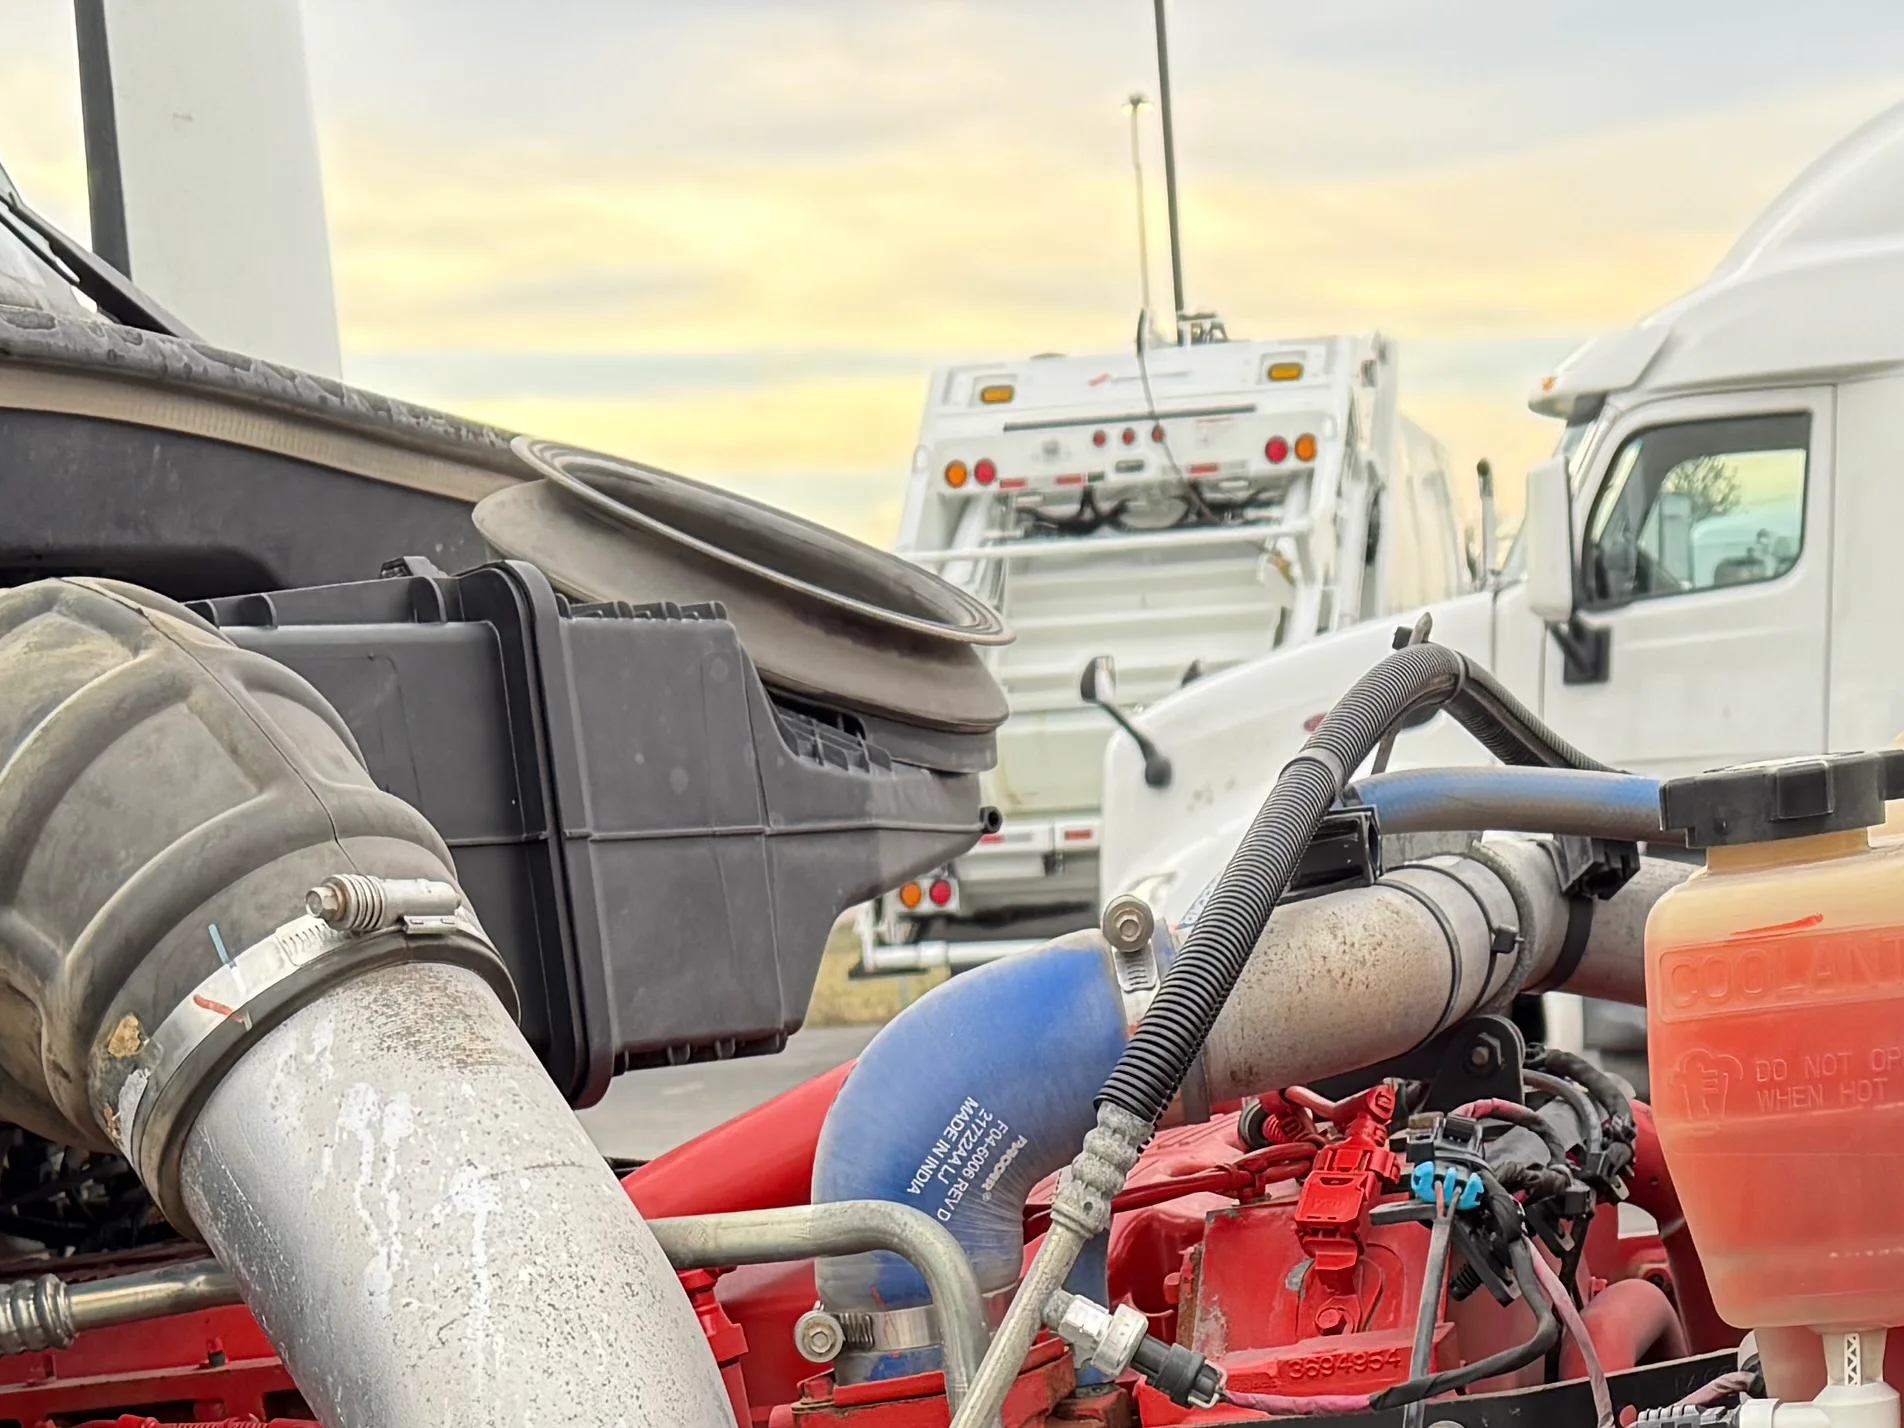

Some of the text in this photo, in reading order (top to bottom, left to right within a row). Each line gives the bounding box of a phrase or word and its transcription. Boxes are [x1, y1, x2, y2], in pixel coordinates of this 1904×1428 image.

[1756, 1058, 1788, 1083] DO
[1805, 1051, 1853, 1080] NOT
[1757, 1078, 1888, 1113] WHEN HOT
[907, 1096, 979, 1194] MADE IN INDIA
[937, 1108, 993, 1184] 21722AA LJ
[937, 1120, 1009, 1221] F04-6006 REV D
[1289, 1348, 1401, 1379] 3694954
